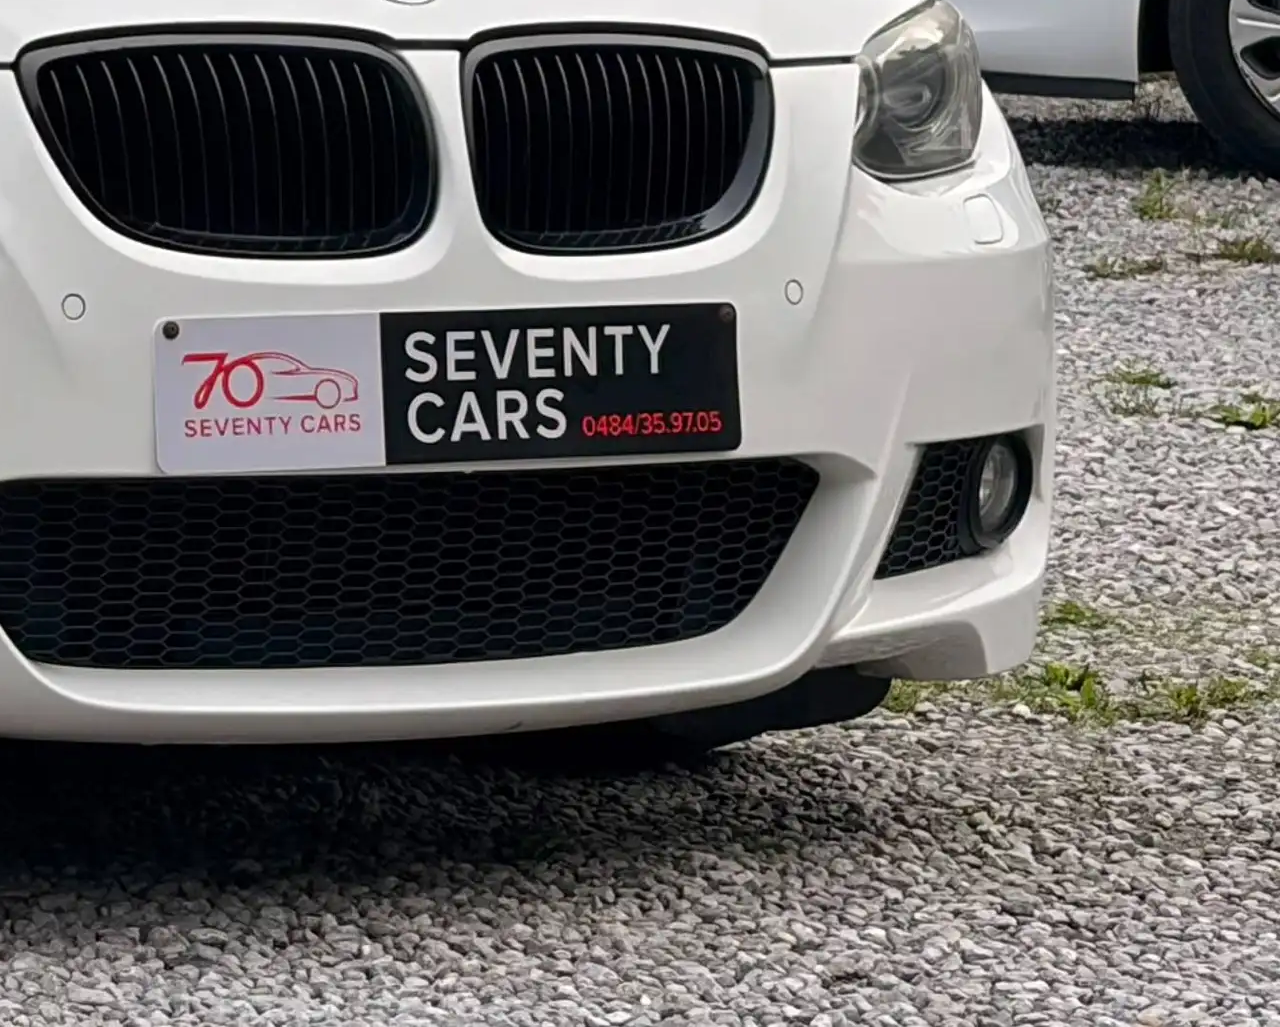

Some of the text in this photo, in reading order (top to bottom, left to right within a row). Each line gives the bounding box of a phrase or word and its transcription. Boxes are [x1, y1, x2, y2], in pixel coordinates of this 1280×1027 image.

[181, 351, 265, 410] 70
[404, 323, 671, 384] SEVENTY
[184, 413, 361, 438] SEVENTY CARS
[406, 388, 568, 444] CARS
[581, 410, 724, 437] 0484/35.97.05
